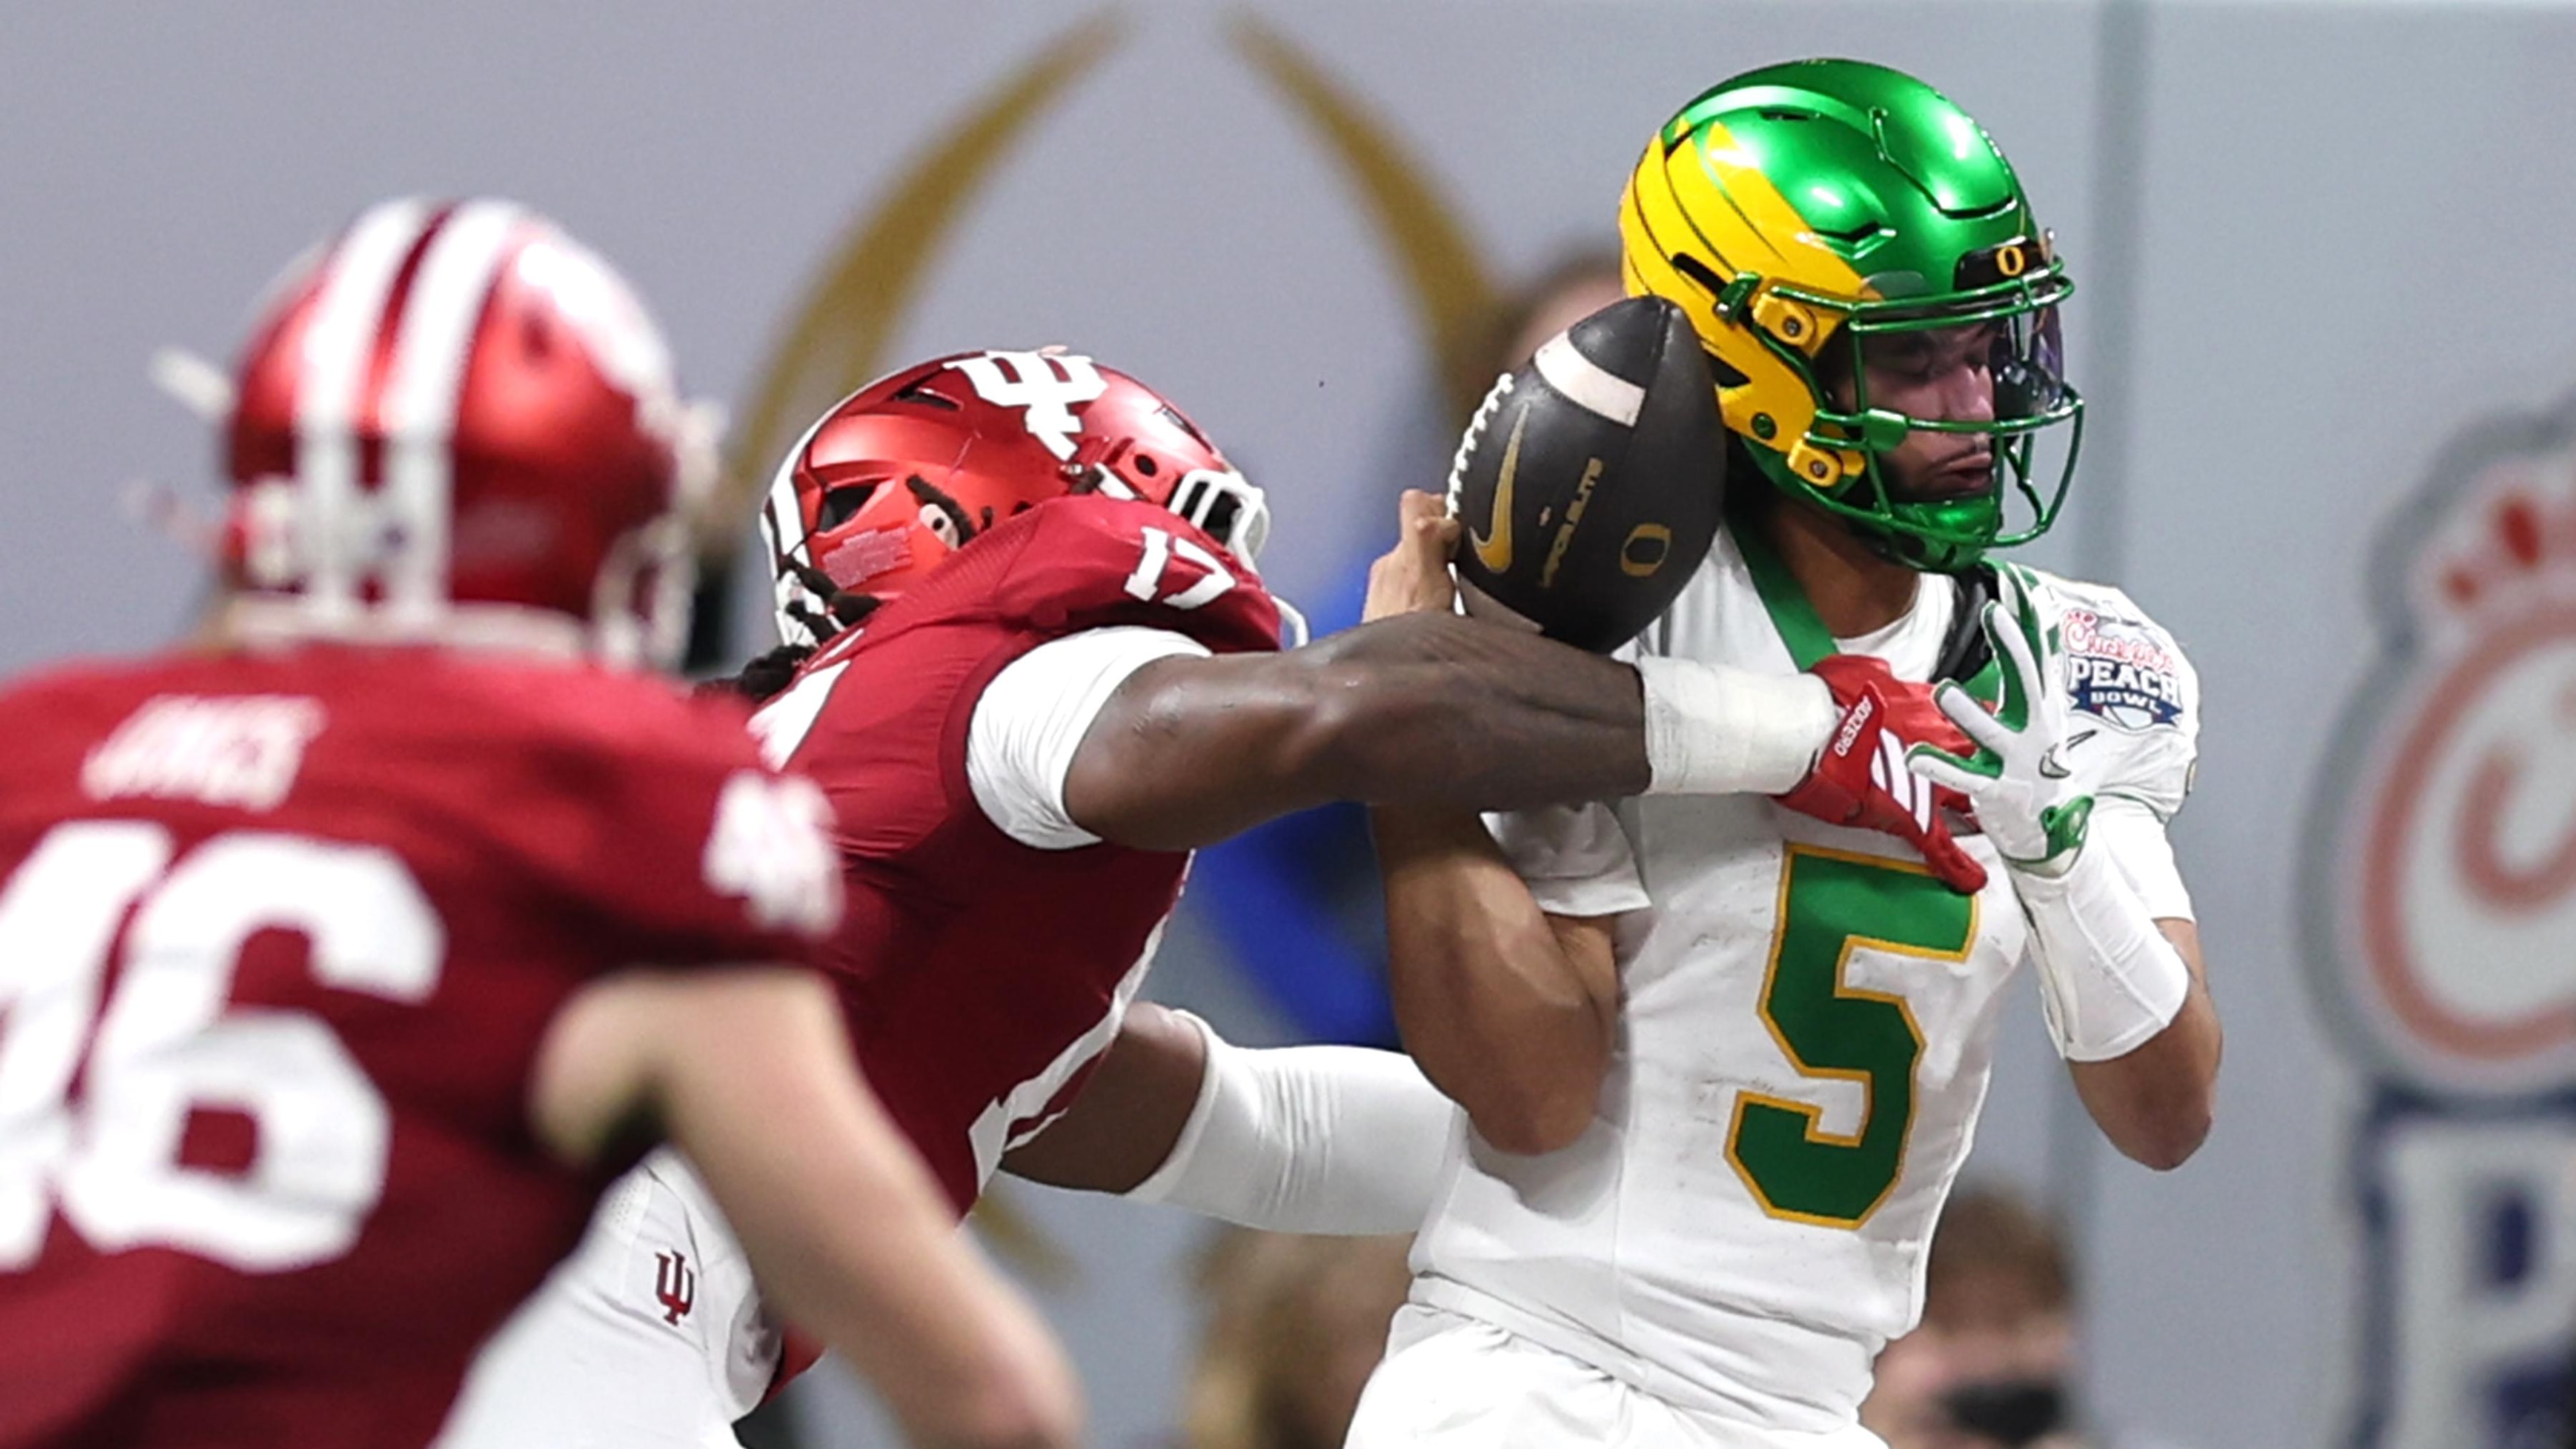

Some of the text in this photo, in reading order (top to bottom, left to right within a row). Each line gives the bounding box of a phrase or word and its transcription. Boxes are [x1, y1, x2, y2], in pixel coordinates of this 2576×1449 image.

[1124, 527, 1236, 610] 17
[2068, 656, 2180, 710] PEACH
[2090, 691, 2162, 714] BOWL
[1724, 840, 1980, 1231] 5
